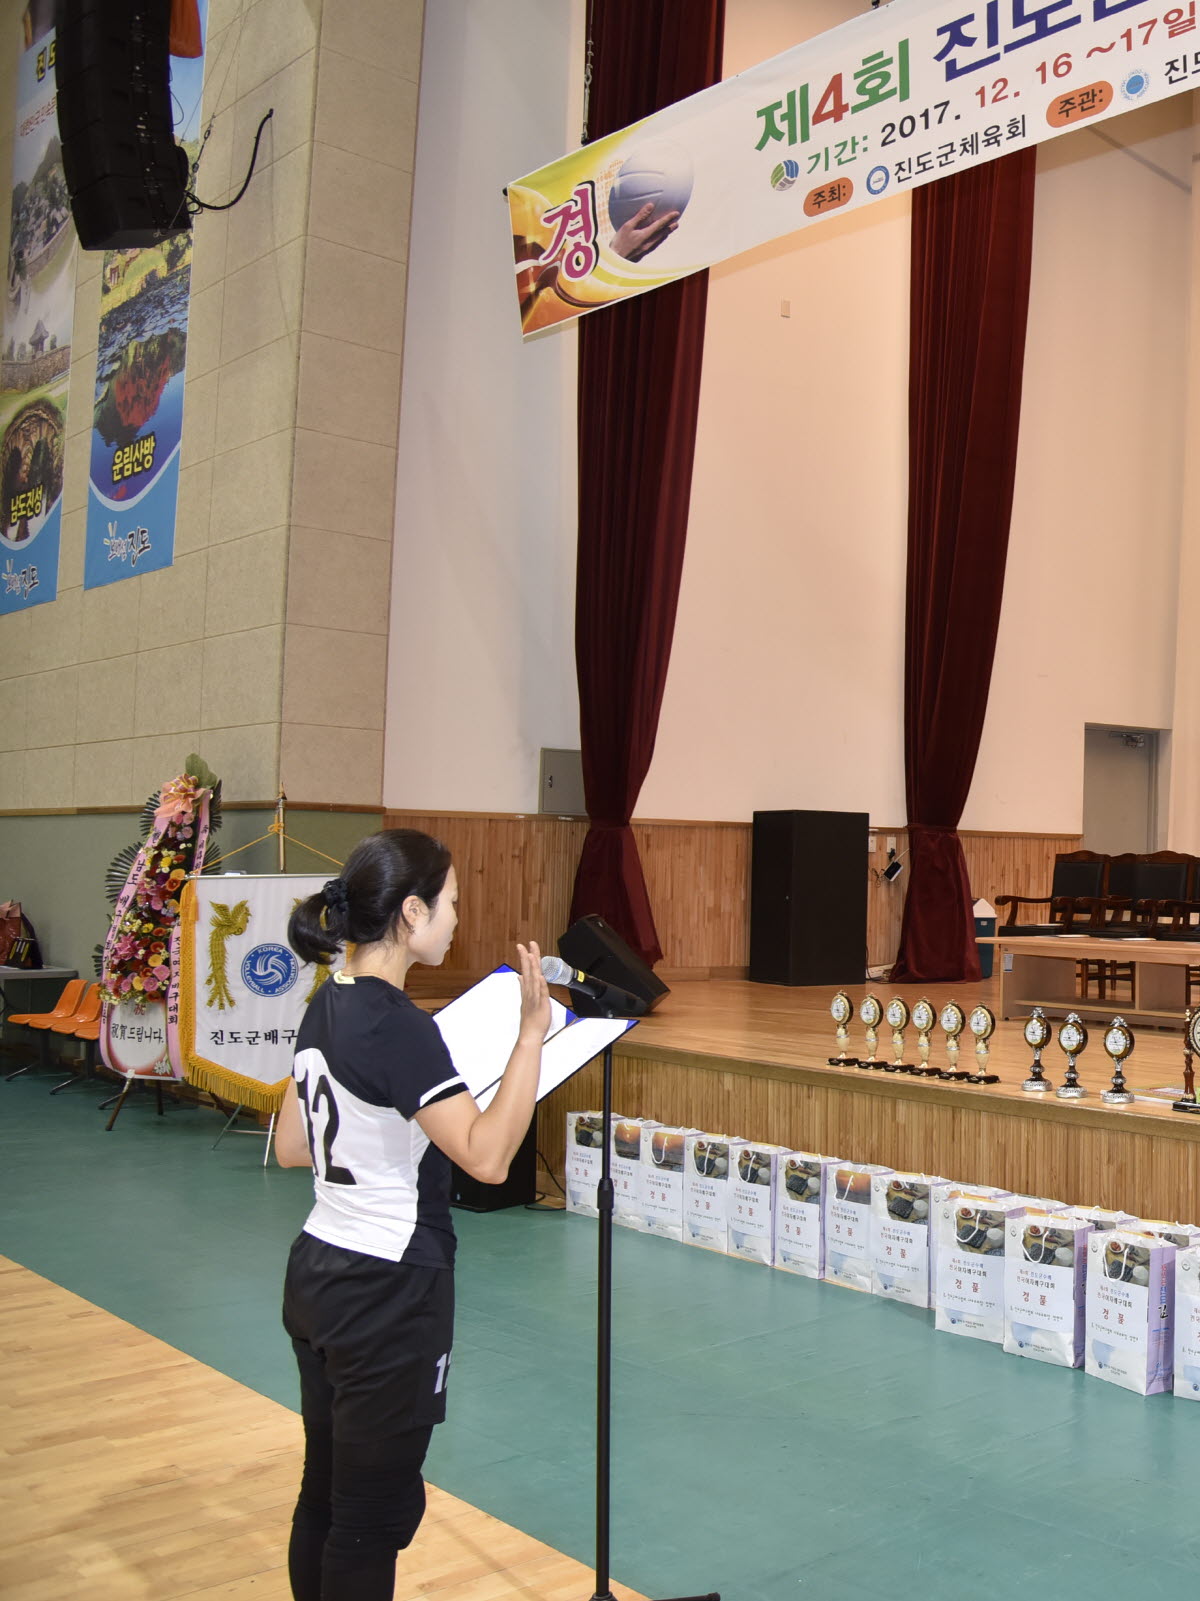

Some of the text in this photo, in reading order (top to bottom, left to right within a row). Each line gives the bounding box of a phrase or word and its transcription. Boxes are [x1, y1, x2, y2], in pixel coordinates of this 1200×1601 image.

[754, 0, 1150, 151] 제4회 진도
[807, 133, 870, 174] 기간:
[880, 99, 962, 148] 2017.
[975, 77, 1021, 108] 12.
[1035, 52, 1073, 85] 16
[811, 184, 848, 210] 주최:
[893, 113, 1027, 183] 진도군체육회
[1057, 88, 1104, 118] 주관:
[540, 181, 599, 280] 경
[10, 485, 43, 524] 남도진성
[112, 434, 156, 483] 운림산방
[258, 946, 283, 954] KOREA
[297, 1068, 358, 1186] 12
[434, 1350, 452, 1394] 1
